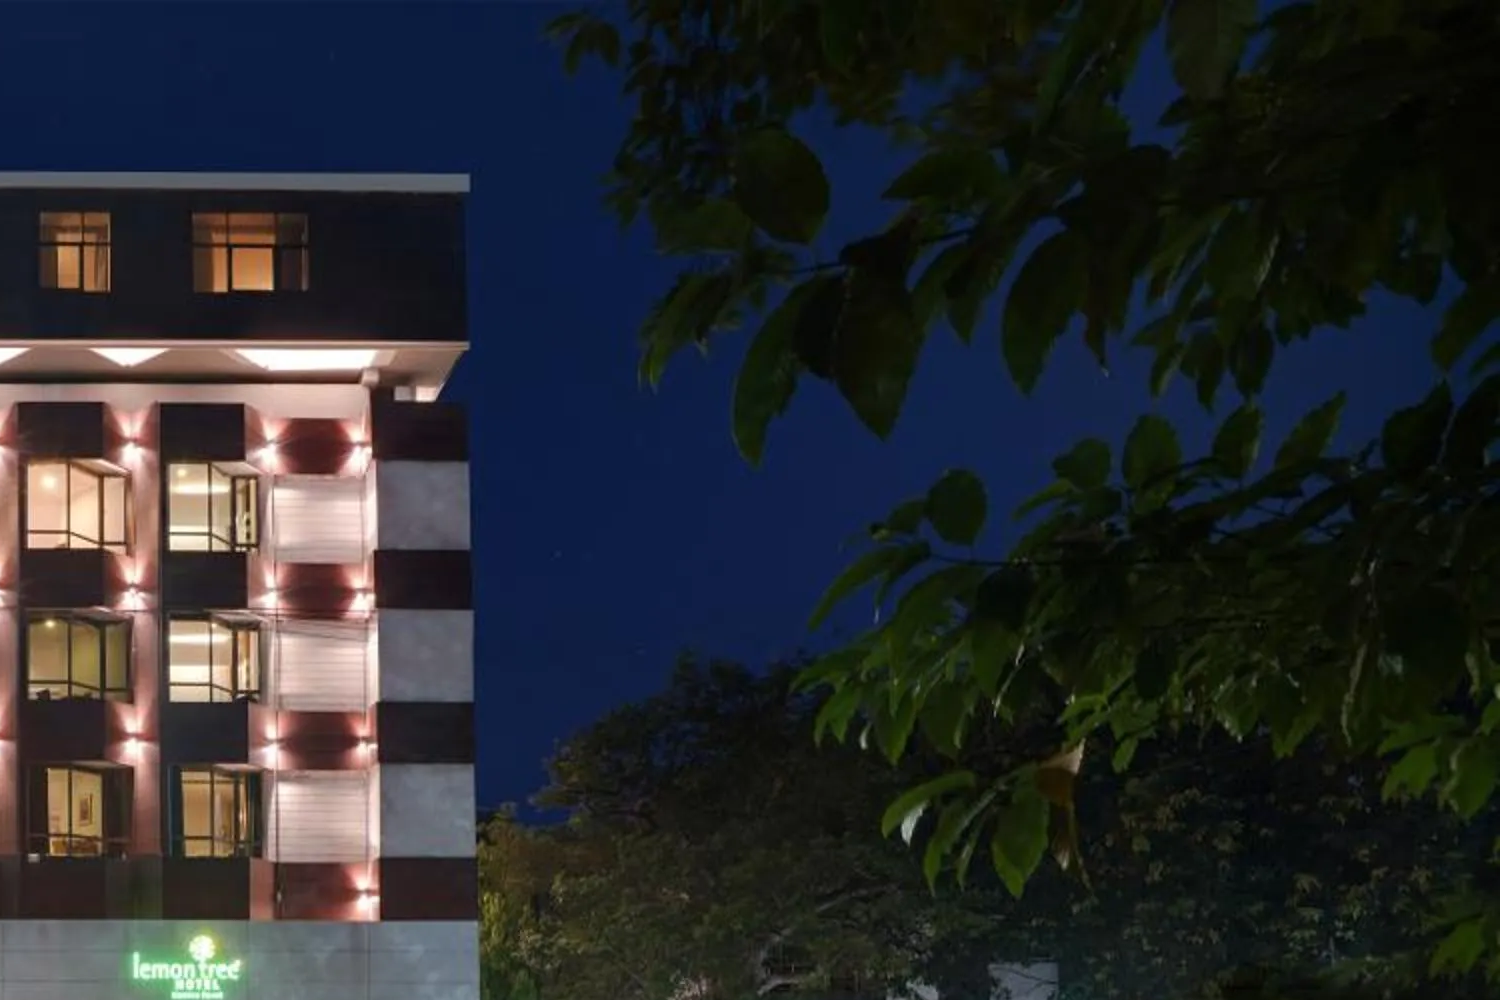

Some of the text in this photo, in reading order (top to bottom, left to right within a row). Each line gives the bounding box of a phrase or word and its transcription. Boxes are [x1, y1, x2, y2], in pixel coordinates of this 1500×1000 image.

[132, 952, 242, 980] lemon tree
[175, 979, 220, 991] HOTEL
